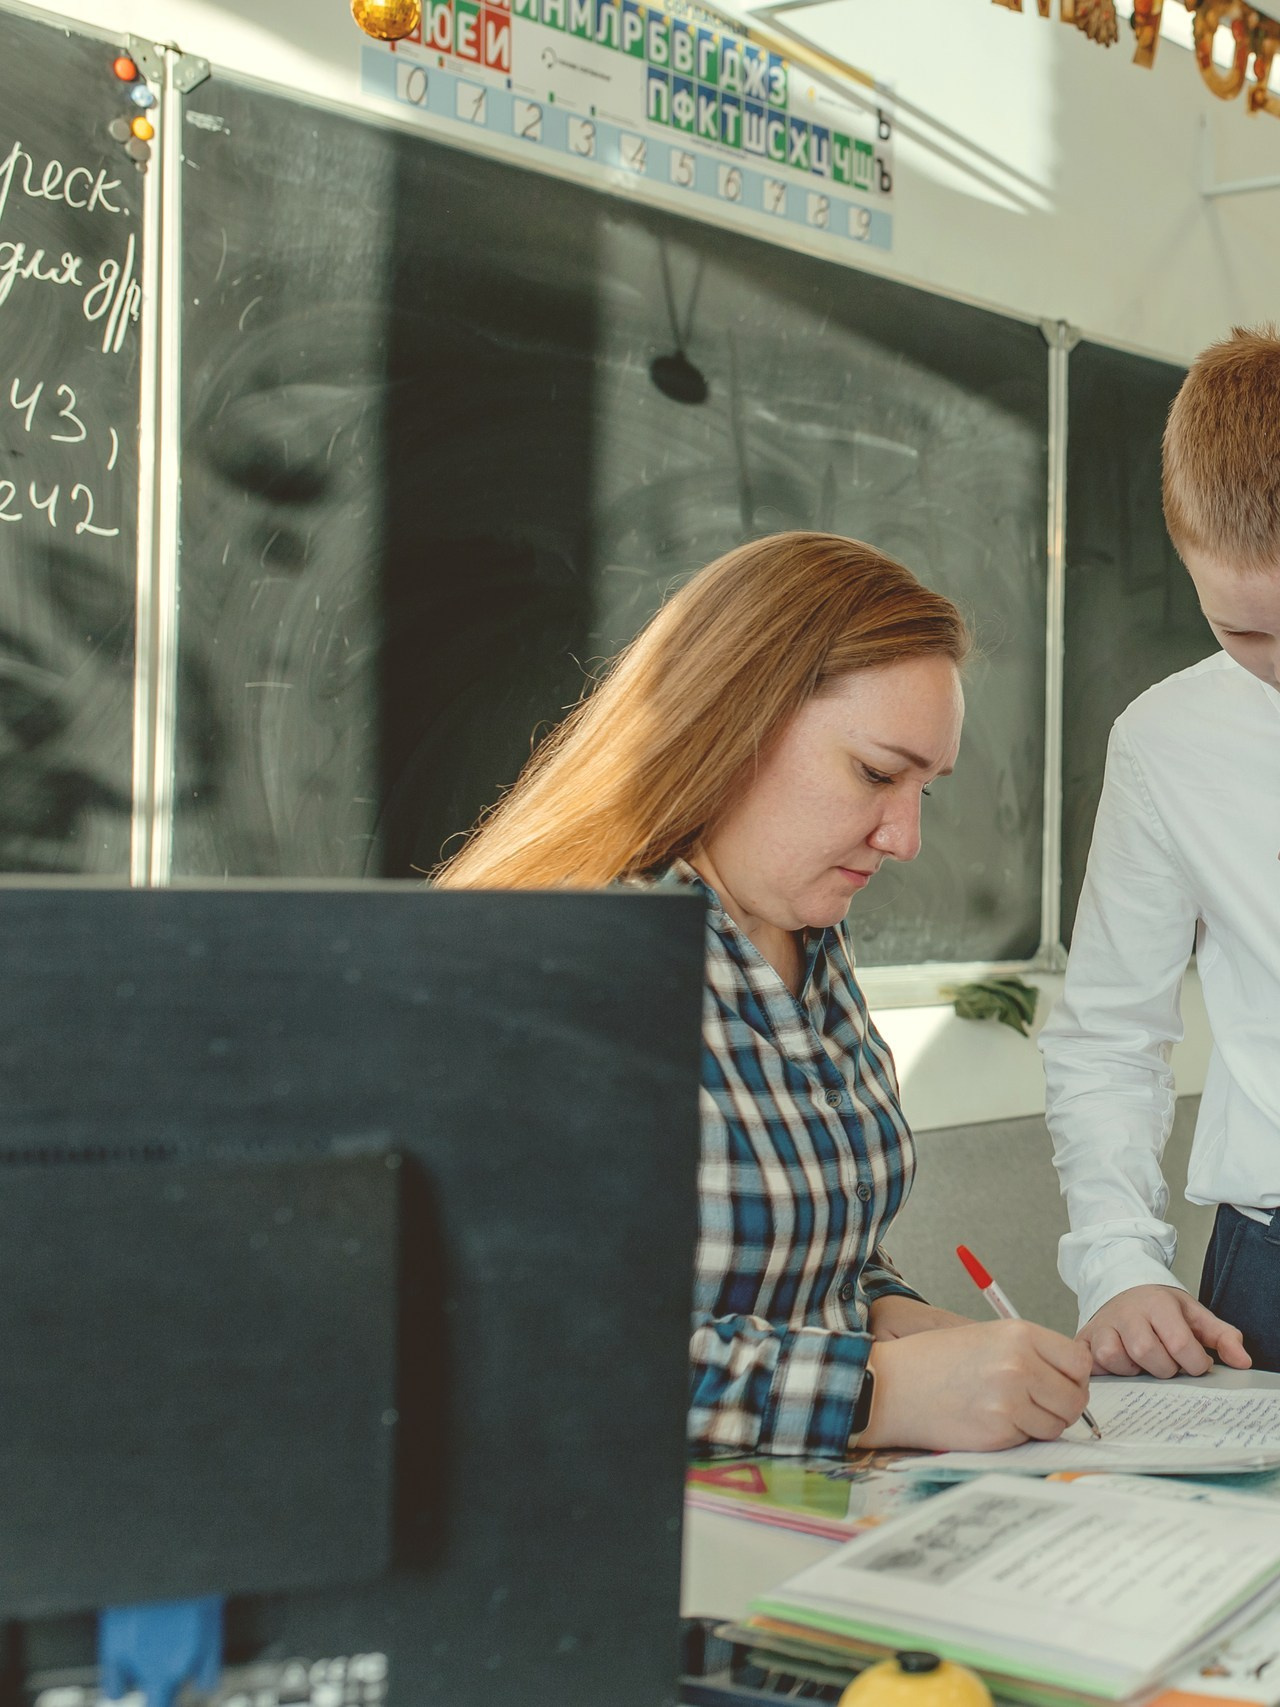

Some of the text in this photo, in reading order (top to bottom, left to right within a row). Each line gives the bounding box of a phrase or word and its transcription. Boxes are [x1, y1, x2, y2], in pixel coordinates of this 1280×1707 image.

[425, 4, 510, 70] Ю Е И
[406, 66, 428, 105] 0
[472, 88, 487, 123] 1
[521, 103, 543, 141] 2
[575, 120, 596, 156] 3
[630, 139, 646, 174] 4
[675, 151, 695, 186] 5
[724, 167, 743, 202] 6
[769, 179, 787, 214] 7
[814, 195, 830, 229] 8
[854, 207, 872, 240] 9
